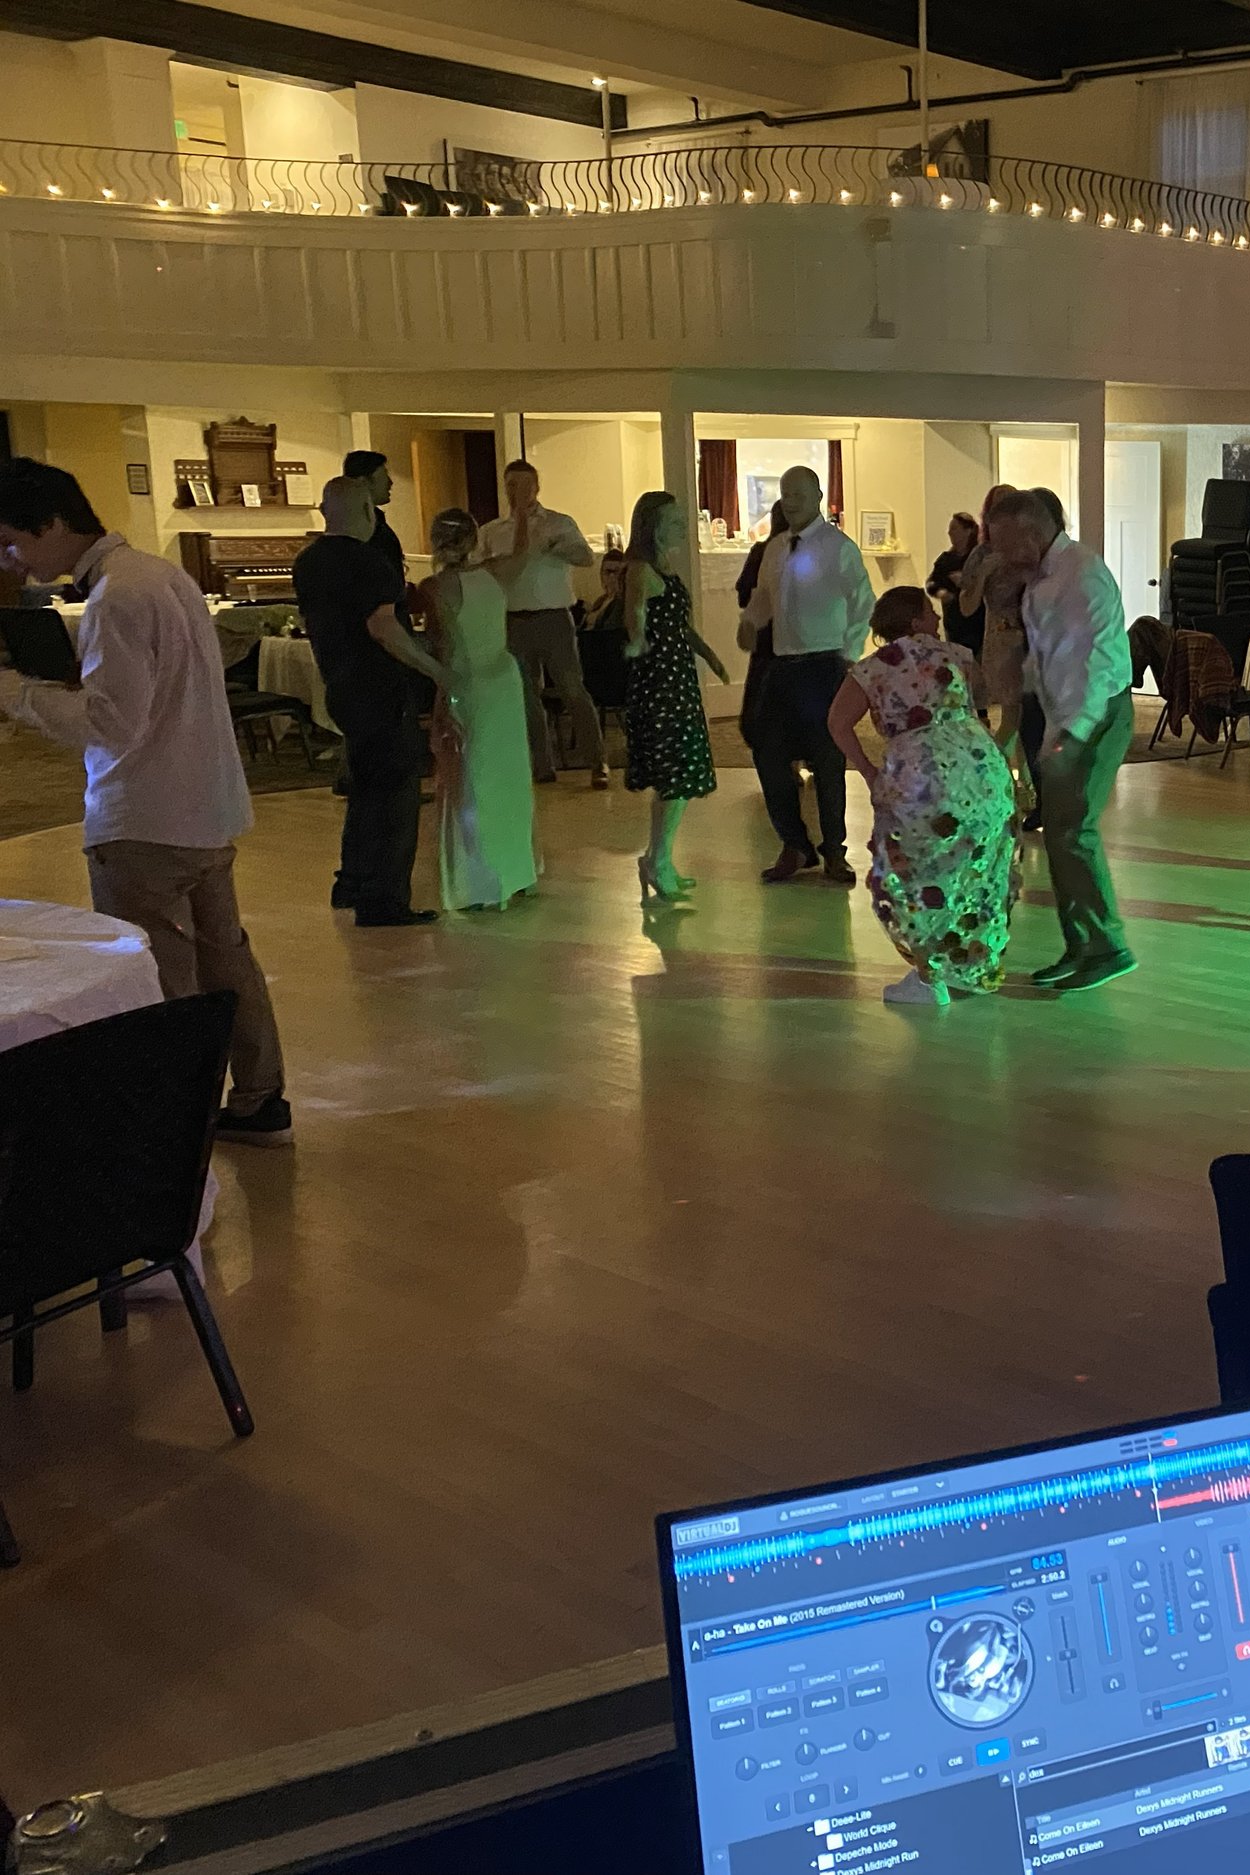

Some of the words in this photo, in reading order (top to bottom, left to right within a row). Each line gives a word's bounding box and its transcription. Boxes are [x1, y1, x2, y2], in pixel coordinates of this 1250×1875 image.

[733, 1620, 757, 1635] Take
[757, 1617, 772, 1629] On
[773, 1615, 788, 1627] Me
[789, 1609, 815, 1625] (2015
[816, 1597, 869, 1617] Remastered
[868, 1589, 905, 1605] Version)
[692, 1641, 701, 1651] A
[948, 1755, 963, 1766] CUE
[1136, 1802, 1159, 1815] Dexys
[1160, 1793, 1192, 1808] Midnight
[1193, 1784, 1223, 1799] Runners
[844, 1829, 868, 1842] World
[870, 1822, 897, 1835] Clique
[1038, 1828, 1062, 1841] Come
[1063, 1823, 1075, 1834] On
[1077, 1818, 1101, 1831] Eileen
[1139, 1823, 1163, 1837] Dexys
[1164, 1814, 1196, 1830] Midnight
[1196, 1805, 1228, 1820] Runners
[835, 1845, 873, 1862] Depeche
[874, 1839, 898, 1852] Mode
[865, 1855, 900, 1872] Midnight
[901, 1850, 919, 1862] Run
[1041, 1849, 1065, 1864] Come
[1066, 1845, 1079, 1857] On
[1080, 1840, 1104, 1854] Eileen
